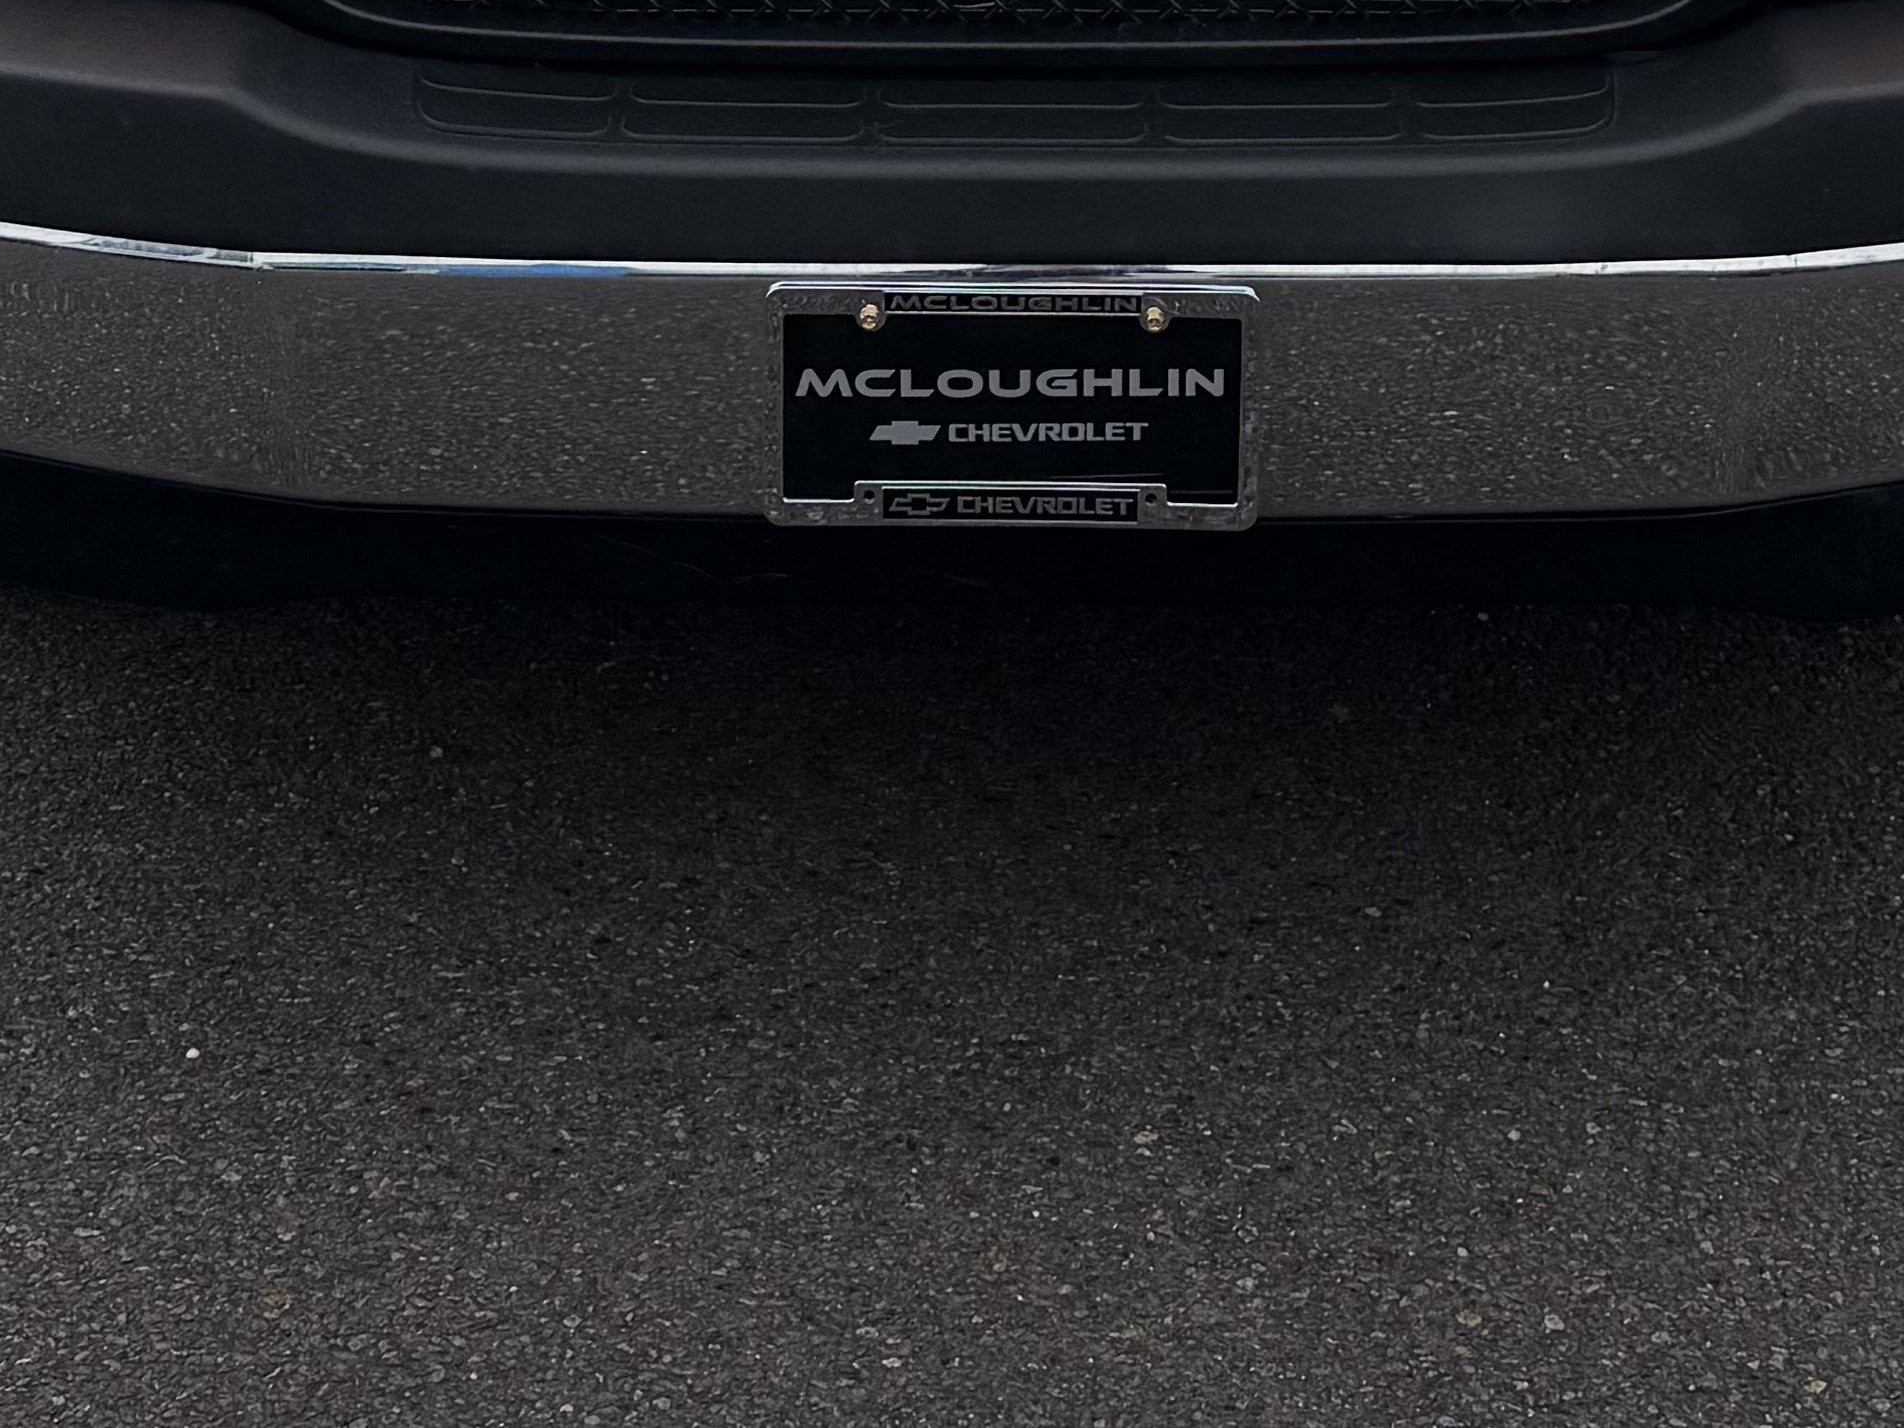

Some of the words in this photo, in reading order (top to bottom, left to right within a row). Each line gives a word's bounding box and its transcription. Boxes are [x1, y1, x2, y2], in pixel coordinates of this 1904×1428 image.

[890, 295, 1138, 312] MCLOUGHLIN
[796, 368, 1225, 398] MCLOUGHLIN
[948, 422, 1149, 443] CHEVROLET
[957, 496, 1134, 516] CHEVROLET
